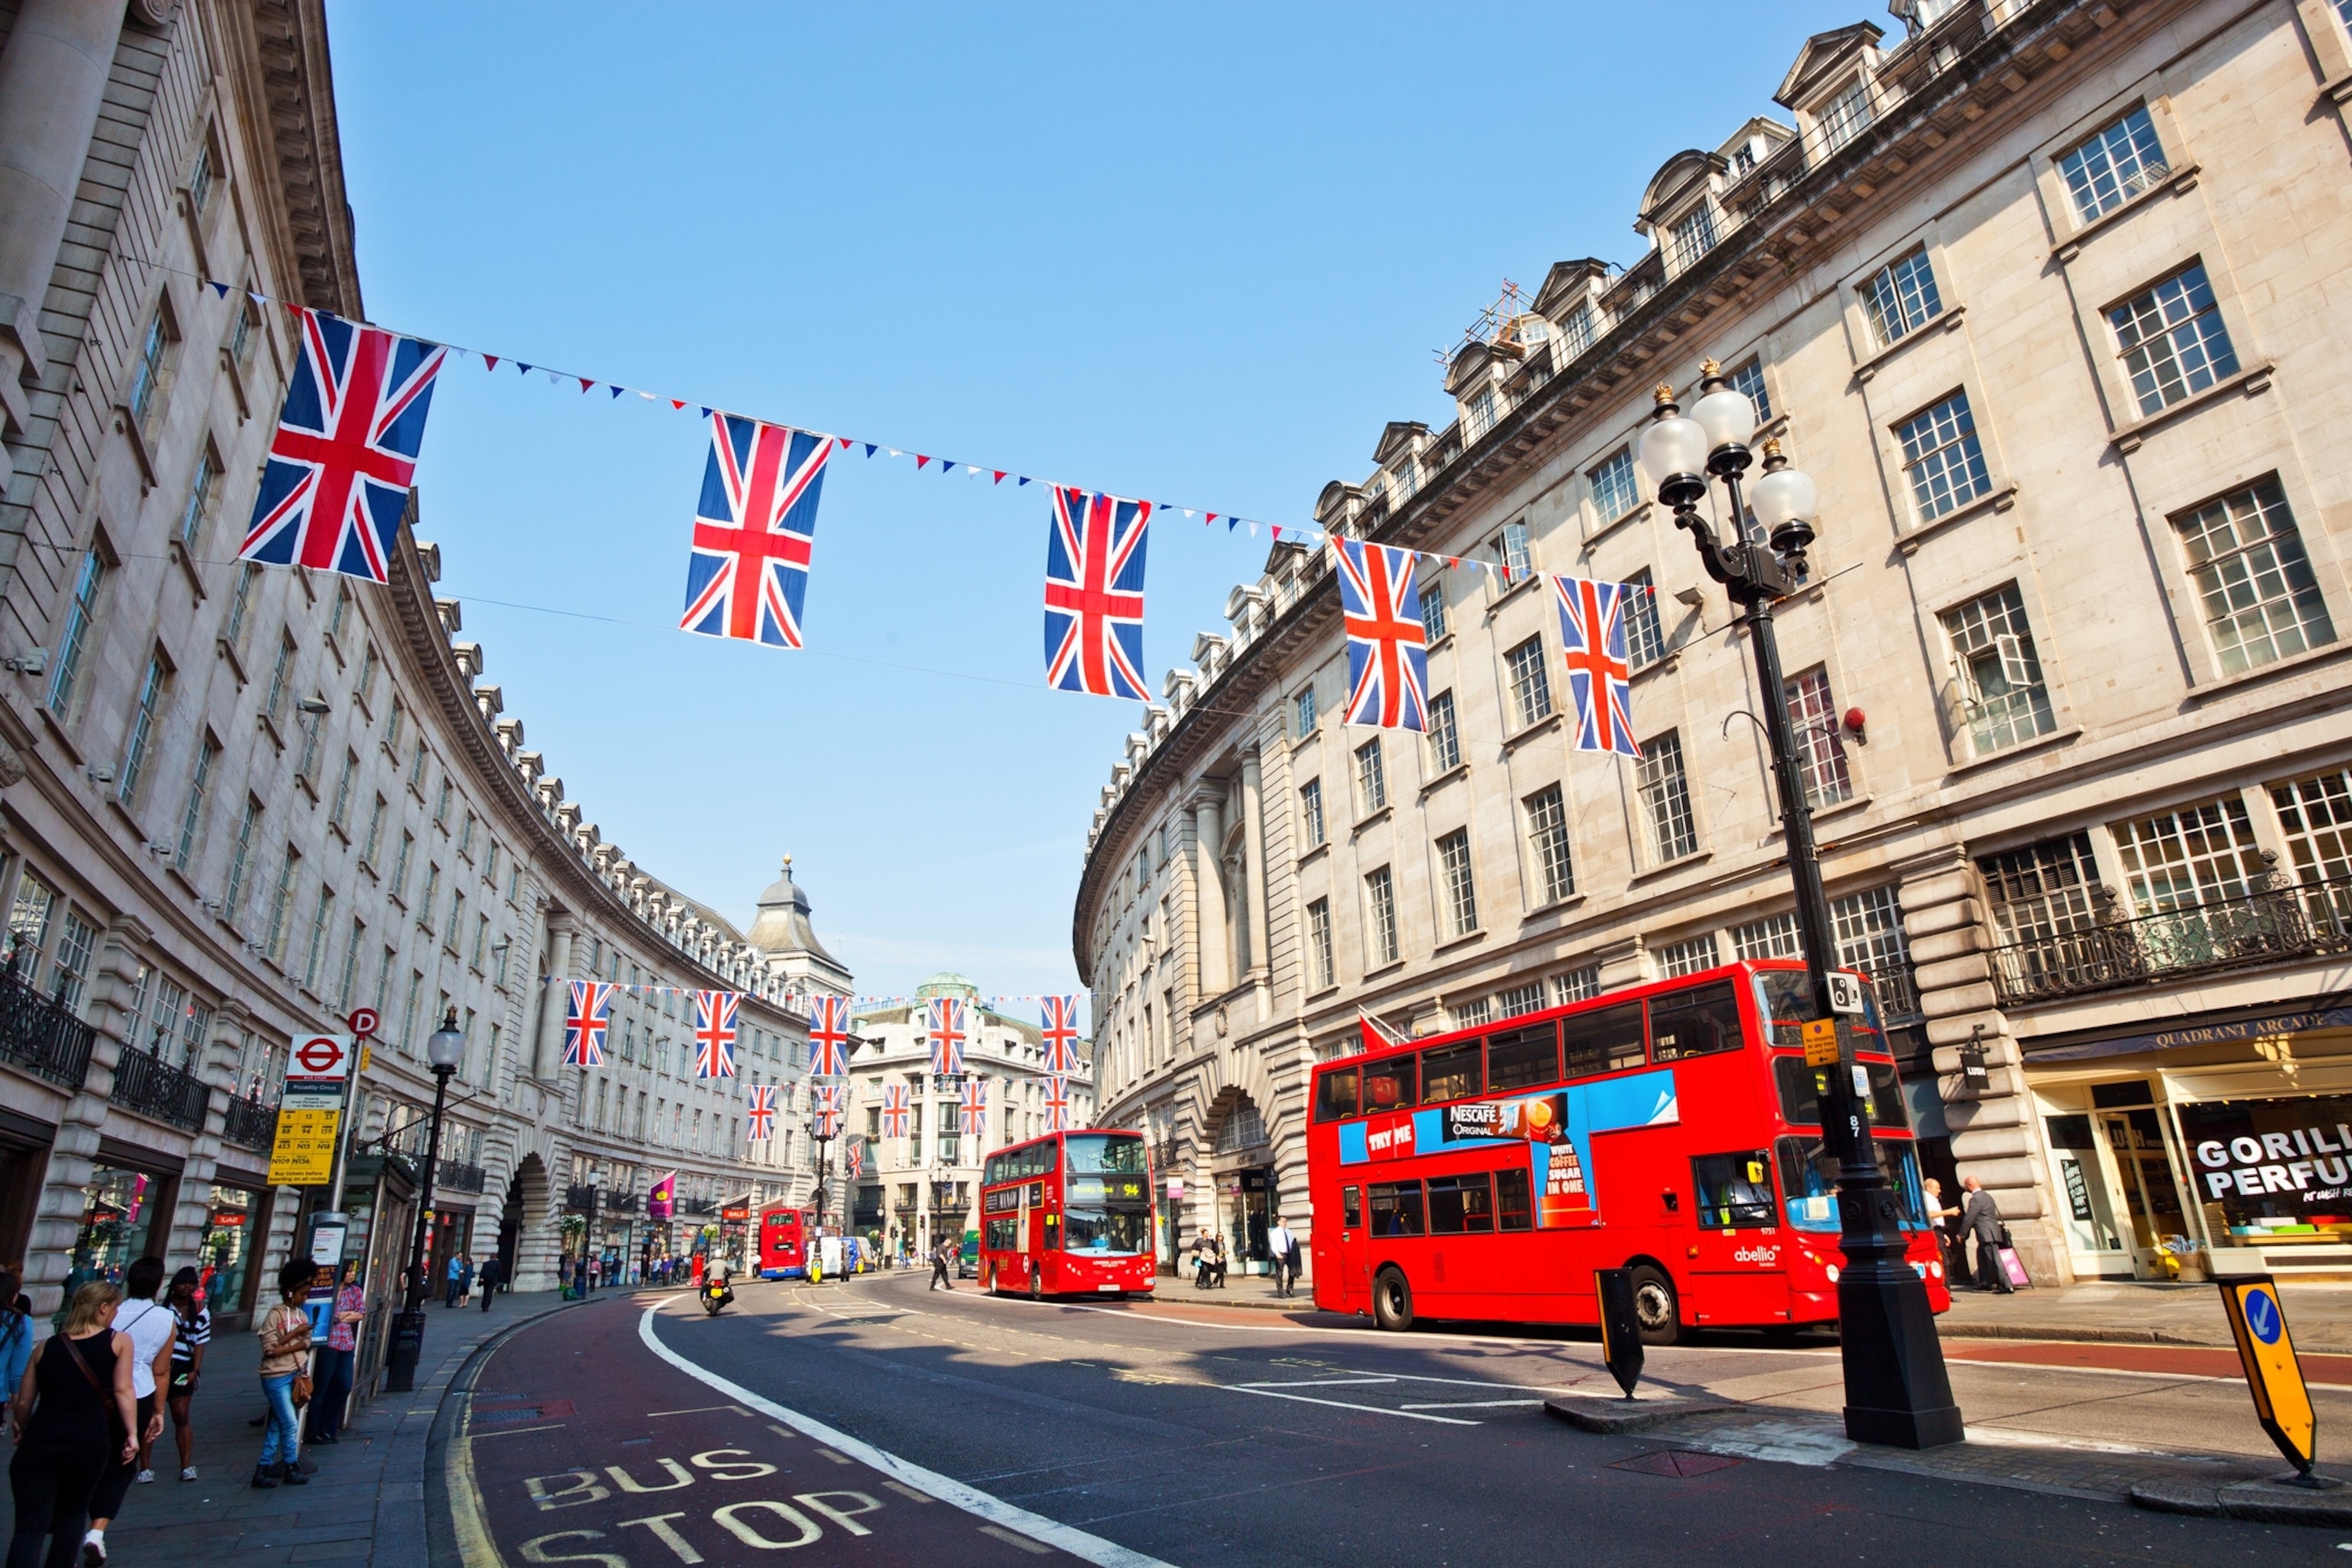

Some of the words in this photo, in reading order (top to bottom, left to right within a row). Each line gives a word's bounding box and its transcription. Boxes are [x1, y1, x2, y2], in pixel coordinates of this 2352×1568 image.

[356, 1013, 375, 1031] D
[2156, 1023, 2248, 1048] QUADRANT
[2255, 1013, 2328, 1034] ARCADE
[1967, 1067, 1986, 1076] LUSH
[1368, 1130, 1393, 1152] TRY
[1393, 1125, 1412, 1145] ME
[1550, 1144, 1573, 1155] WHITE
[1550, 1155, 1578, 1168] COFFEE
[1548, 1168, 1582, 1181] SUGAR
[1123, 1184, 1138, 1196] 94
[1547, 1181, 1560, 1194] IN
[1562, 1179, 1584, 1194] ONE
[1734, 1246, 1775, 1262] abellio
[523, 1449, 778, 1511] BUS
[518, 1490, 886, 1568] STOP
